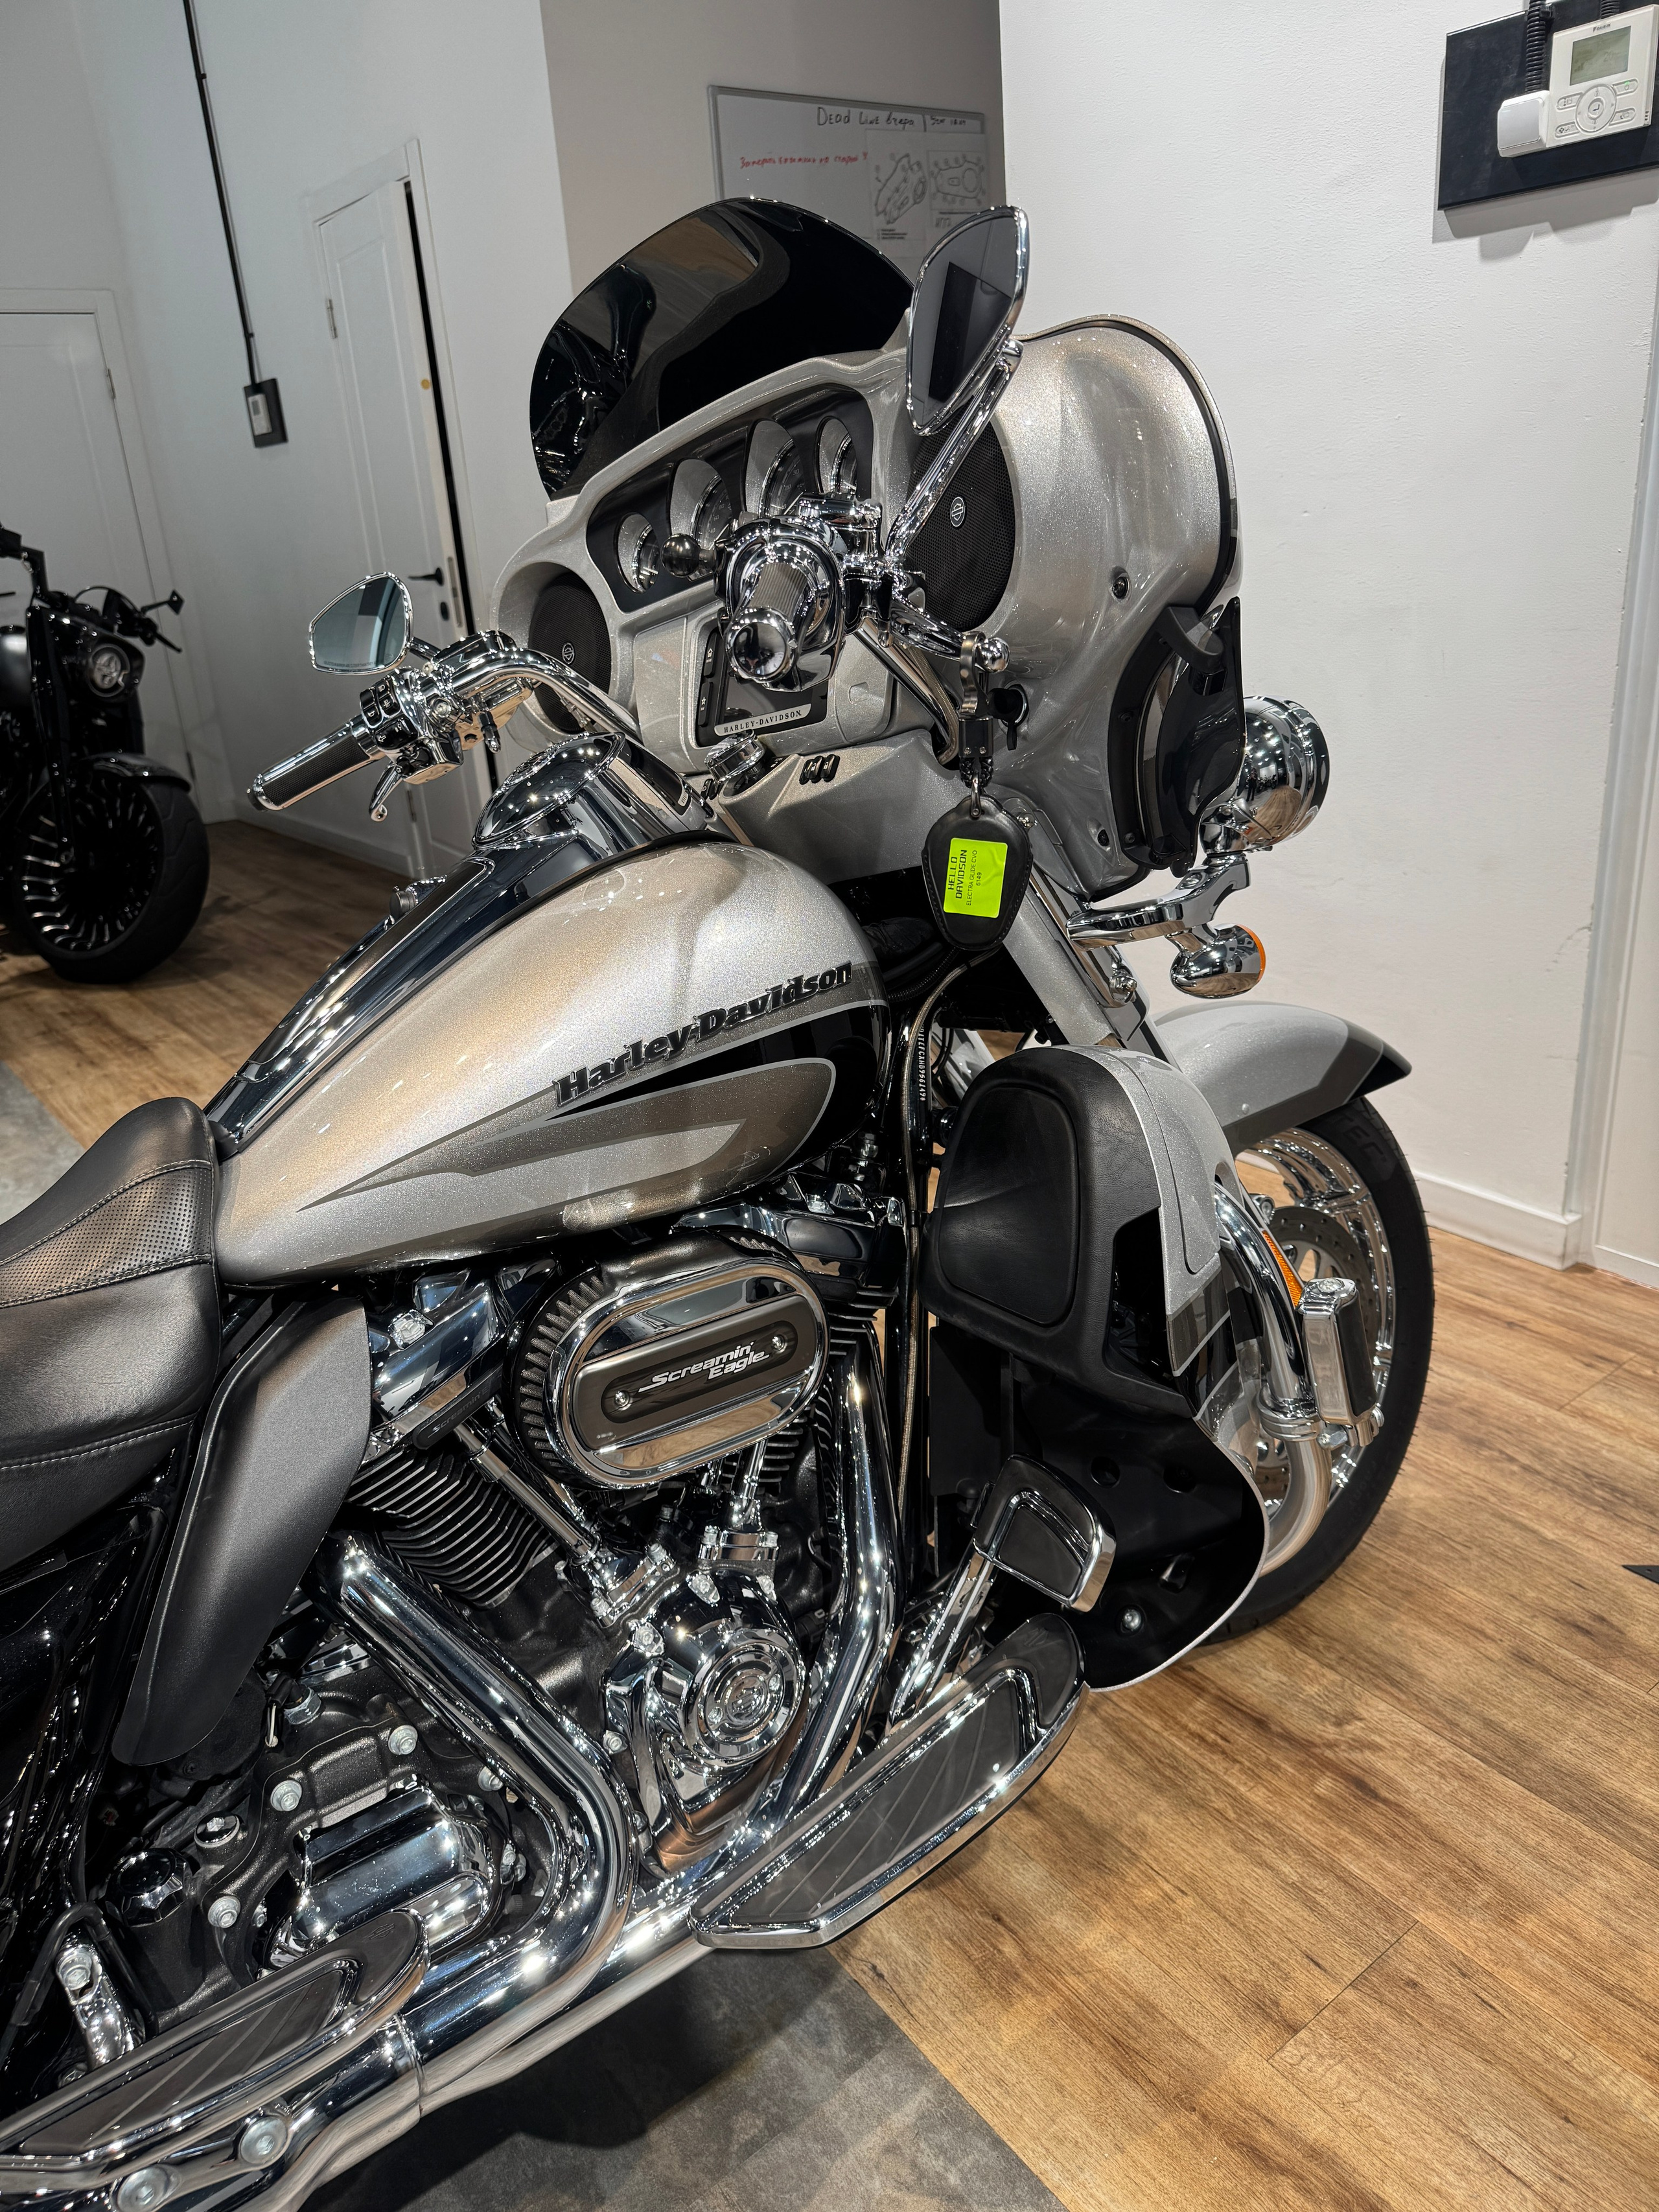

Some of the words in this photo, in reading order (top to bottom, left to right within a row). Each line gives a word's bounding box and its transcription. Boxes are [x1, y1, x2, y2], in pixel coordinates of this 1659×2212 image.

[724, 710, 802, 733] HARLEY-DAVIDSON
[948, 857, 957, 890] HELLO
[955, 850, 967, 899] DAVIDSON
[552, 960, 853, 1107] Harley-Davidson
[638, 1342, 754, 1393] Screamin'
[708, 1351, 770, 1380] Eagle
